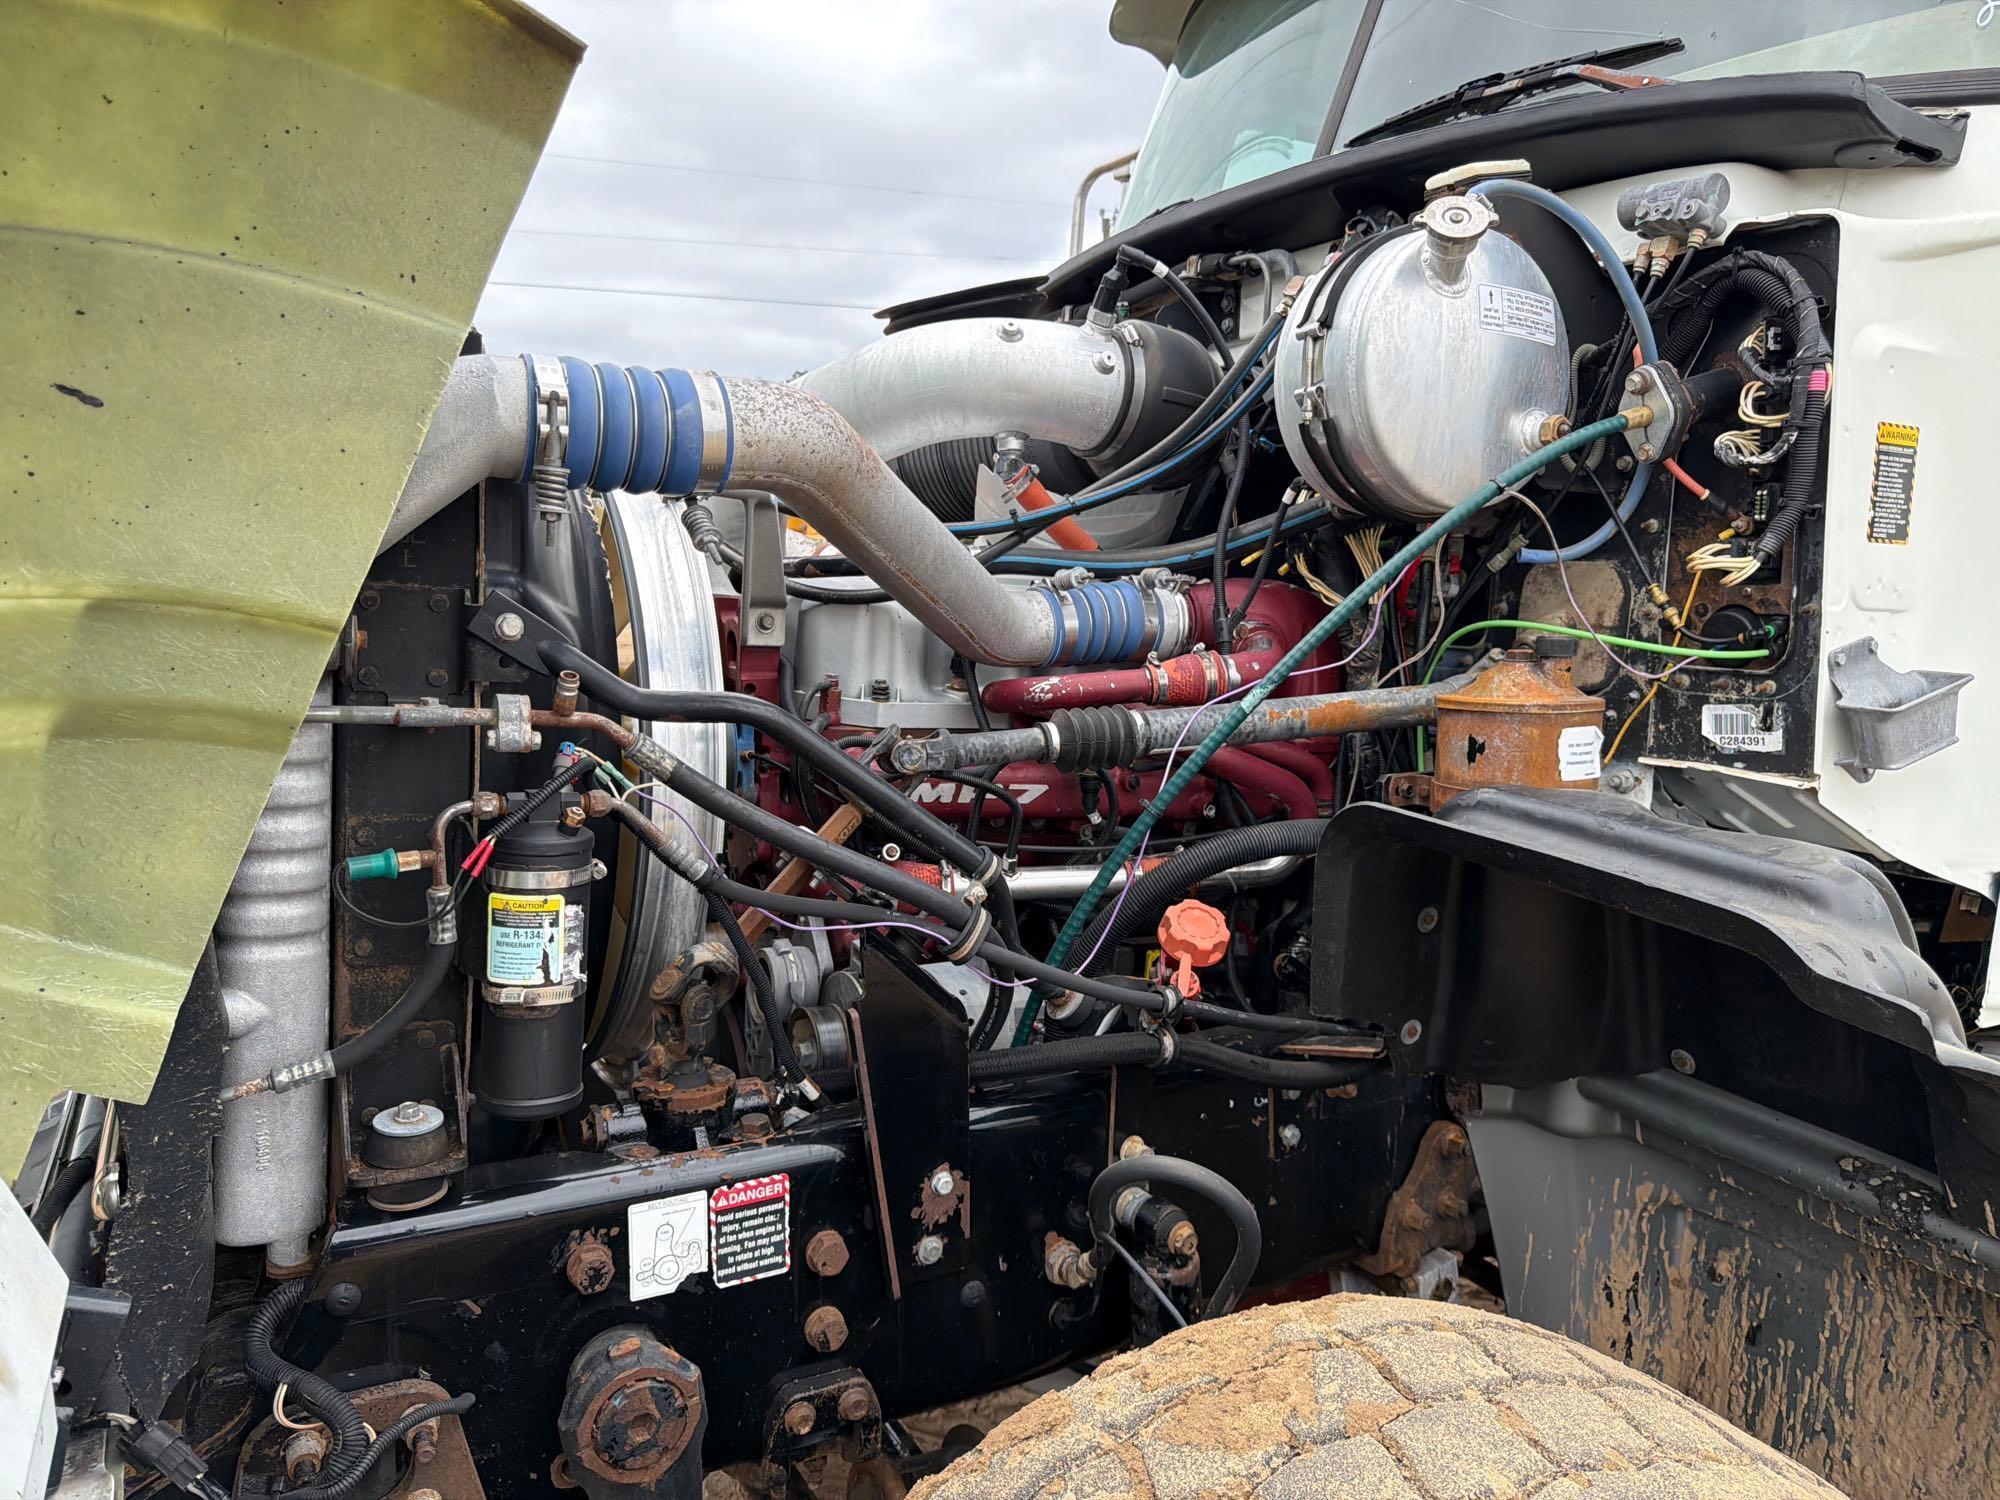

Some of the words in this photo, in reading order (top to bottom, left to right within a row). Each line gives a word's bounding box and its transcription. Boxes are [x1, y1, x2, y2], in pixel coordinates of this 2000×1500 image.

[1886, 431, 1916, 442] WARNING
[1720, 736, 1766, 746] C284391
[496, 940, 534, 949] REFRIGERANT
[663, 1197, 688, 1206] ROUTING
[728, 1183, 783, 1205] DANGER
[717, 1212, 734, 1223] Avoid
[735, 1208, 757, 1220] serious
[758, 1201, 784, 1216] personal
[722, 1223, 741, 1233] injury,
[742, 1218, 763, 1228] remain
[718, 1244, 743, 1255] running.
[744, 1240, 756, 1248] Fan
[757, 1238, 770, 1247] may
[771, 1233, 784, 1241] start
[720, 1235, 726, 1244] of
[727, 1233, 737, 1242] fan
[738, 1231, 754, 1240] when
[755, 1226, 776, 1235] engine
[728, 1255, 734, 1264] to
[735, 1252, 753, 1262] rotate
[761, 1246, 774, 1256] high
[718, 1266, 736, 1277] speed
[737, 1261, 758, 1272] without
[760, 1255, 784, 1266] warning.
